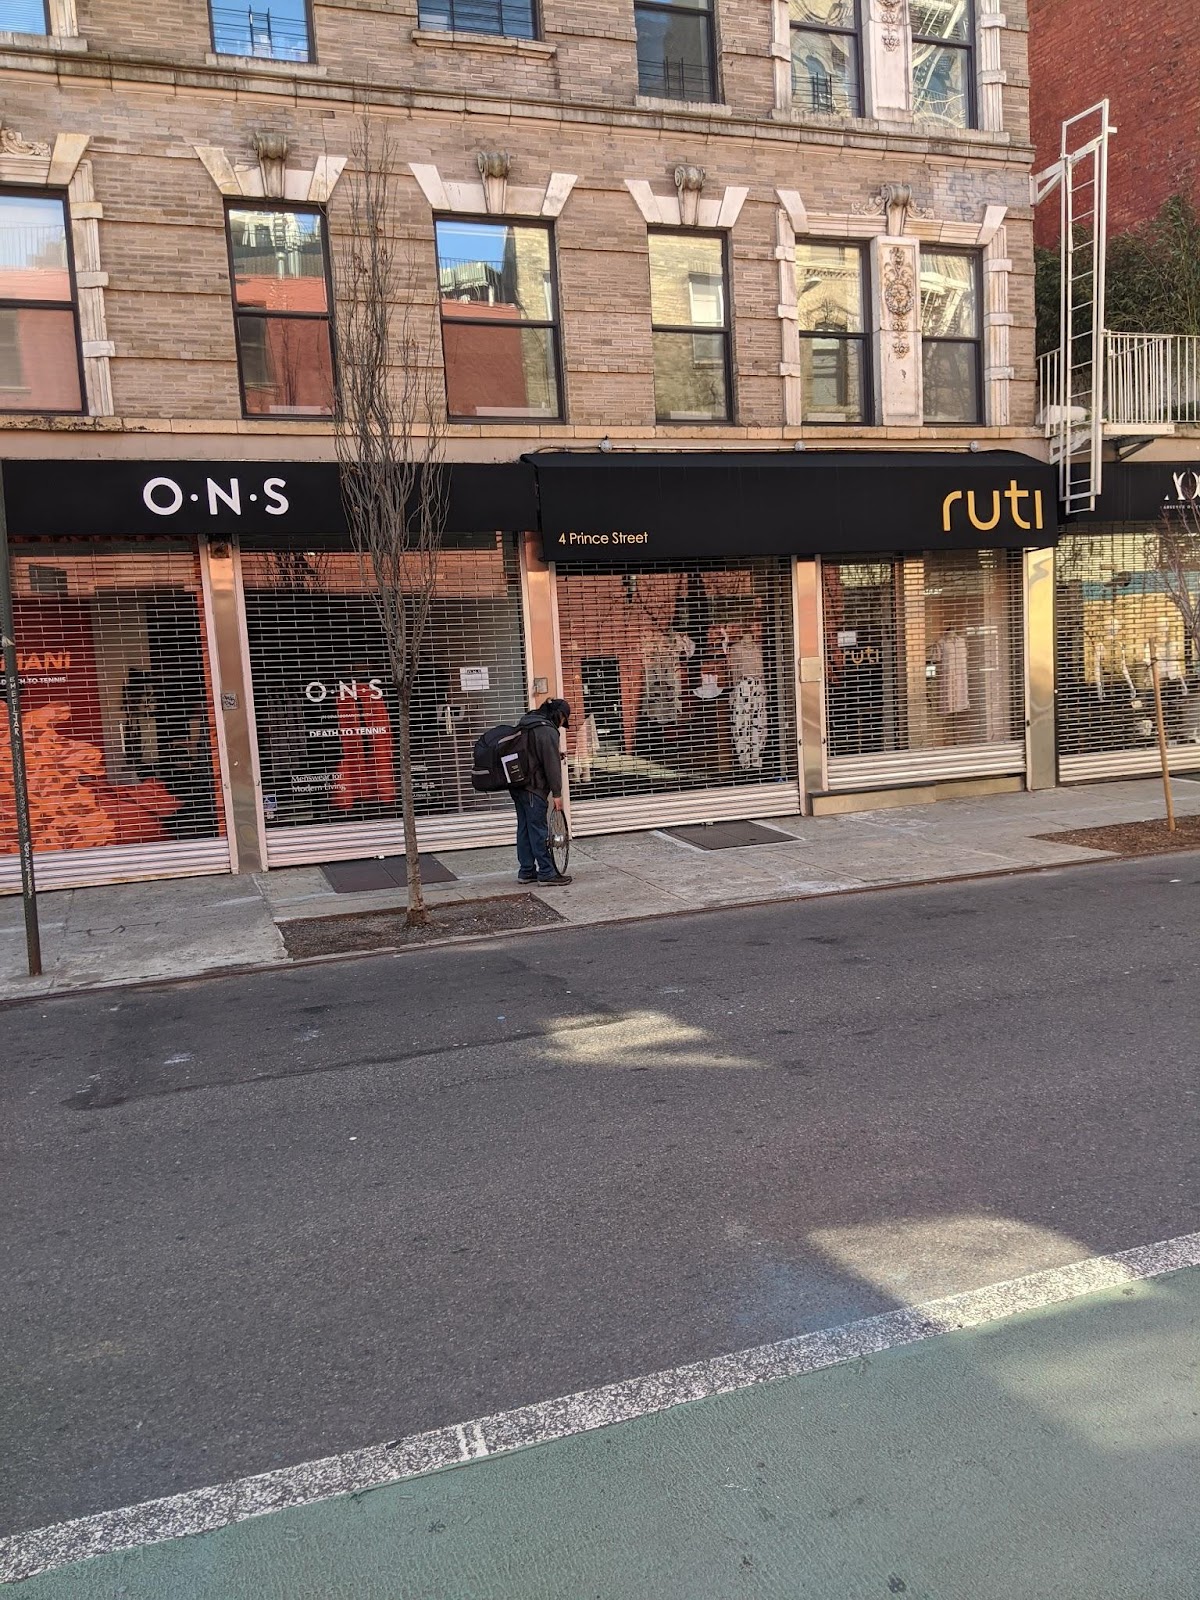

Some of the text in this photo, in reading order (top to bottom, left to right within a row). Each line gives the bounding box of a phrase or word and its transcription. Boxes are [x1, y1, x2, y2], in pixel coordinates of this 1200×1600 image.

[943, 480, 1043, 531] ruti
[558, 531, 648, 545] 4 Prince Street
[39, 676, 67, 684] TENNIS
[309, 726, 387, 737] DEATH TO TENNIS
